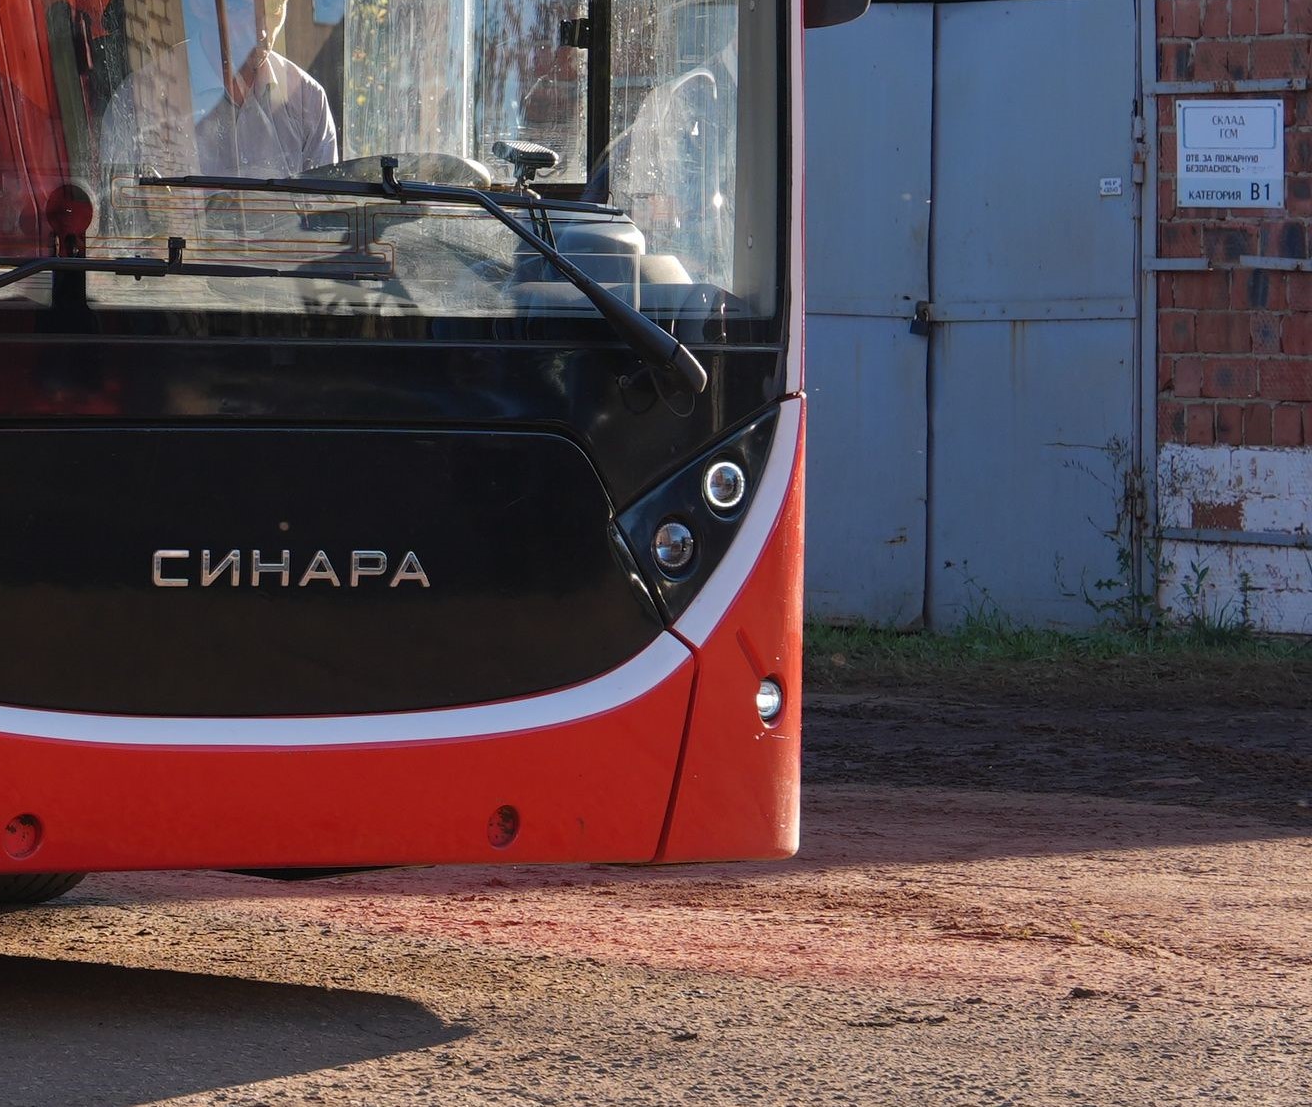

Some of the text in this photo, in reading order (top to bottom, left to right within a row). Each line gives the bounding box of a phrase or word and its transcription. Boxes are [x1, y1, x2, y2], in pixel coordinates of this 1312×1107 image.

[1212, 115, 1245, 126] СКЛАД
[1220, 129, 1238, 139] ГСМ
[1202, 154, 1213, 162] ЗА
[1215, 155, 1259, 163] ПОЖАРНУЮ
[1188, 190, 1242, 201] КАТЕГОРИЯ
[151, 549, 431, 588] СИНАРА
